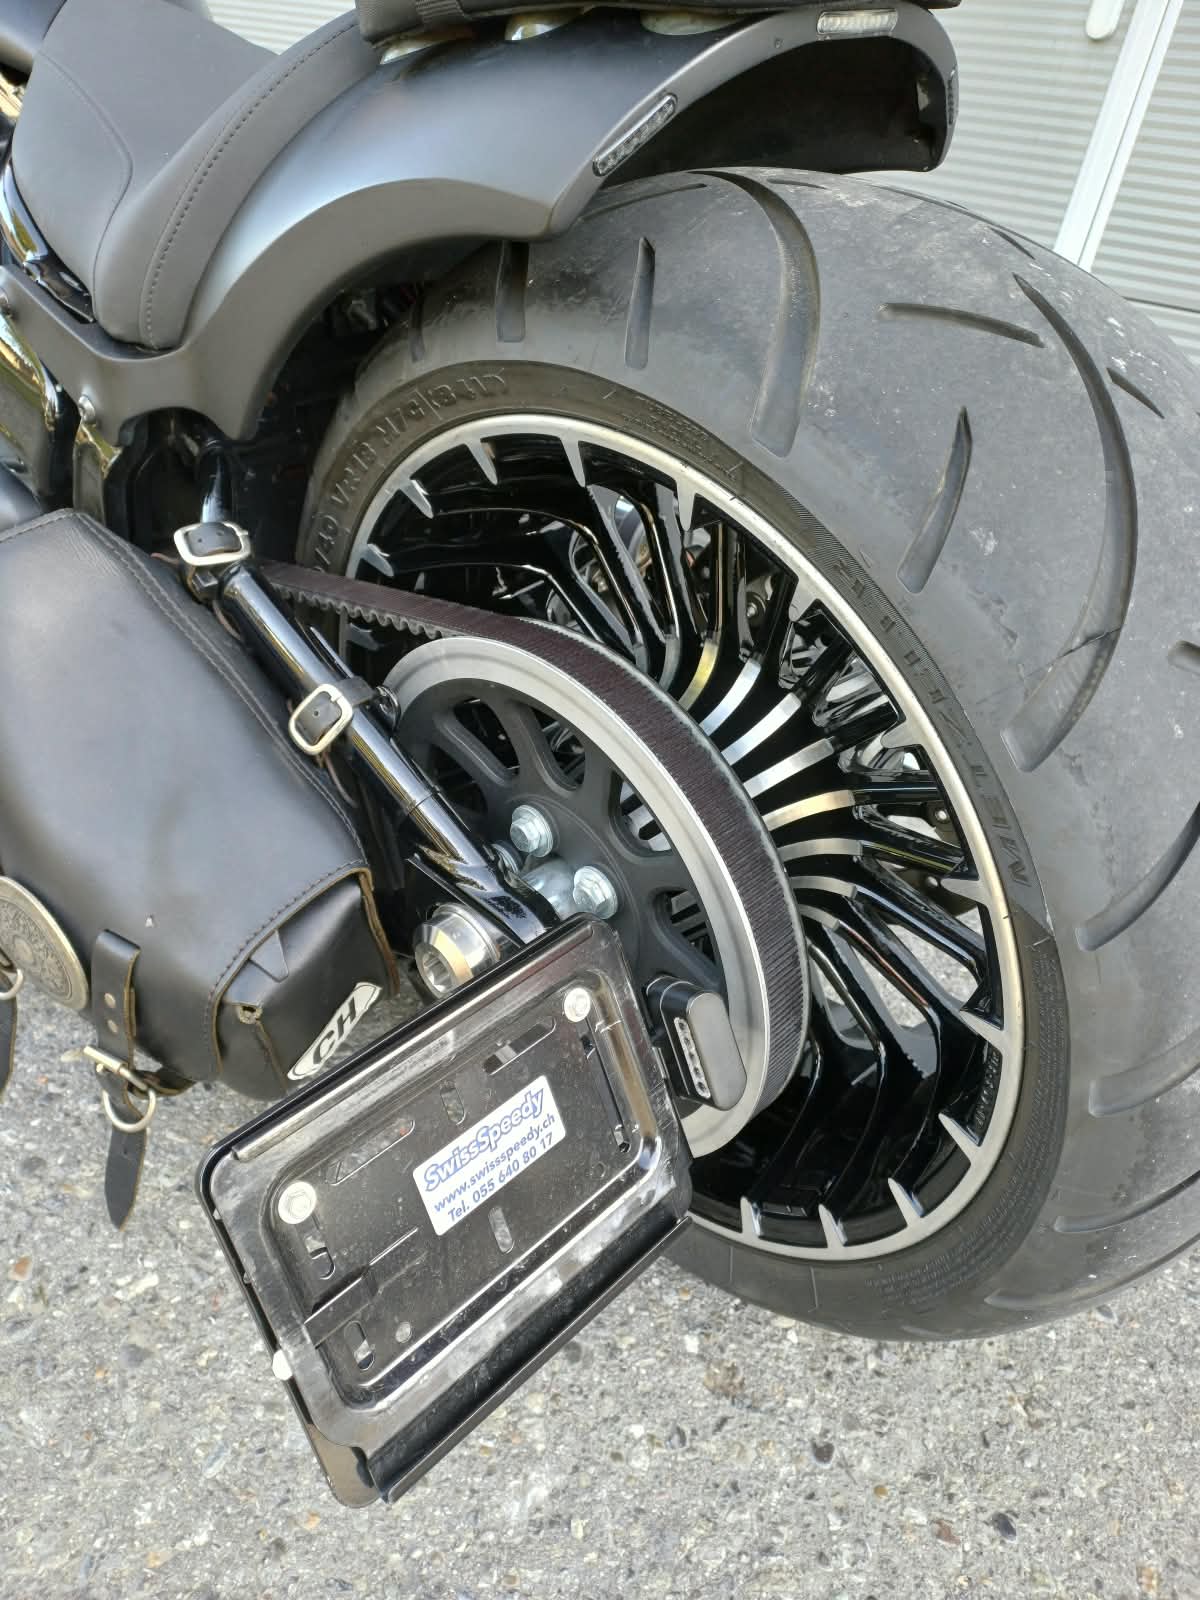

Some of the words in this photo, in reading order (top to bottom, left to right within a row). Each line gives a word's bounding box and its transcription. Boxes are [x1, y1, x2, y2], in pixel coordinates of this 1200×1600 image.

[313, 995, 357, 1066] CH
[423, 1087, 545, 1193] SwissSpeedy
[433, 1112, 557, 1213] www.swissspeedy.ch
[447, 1200, 471, 1223] Tel.
[471, 1178, 496, 1204] 055
[498, 1159, 520, 1184] 640
[522, 1145, 538, 1164] 80
[539, 1131, 554, 1151] 17
